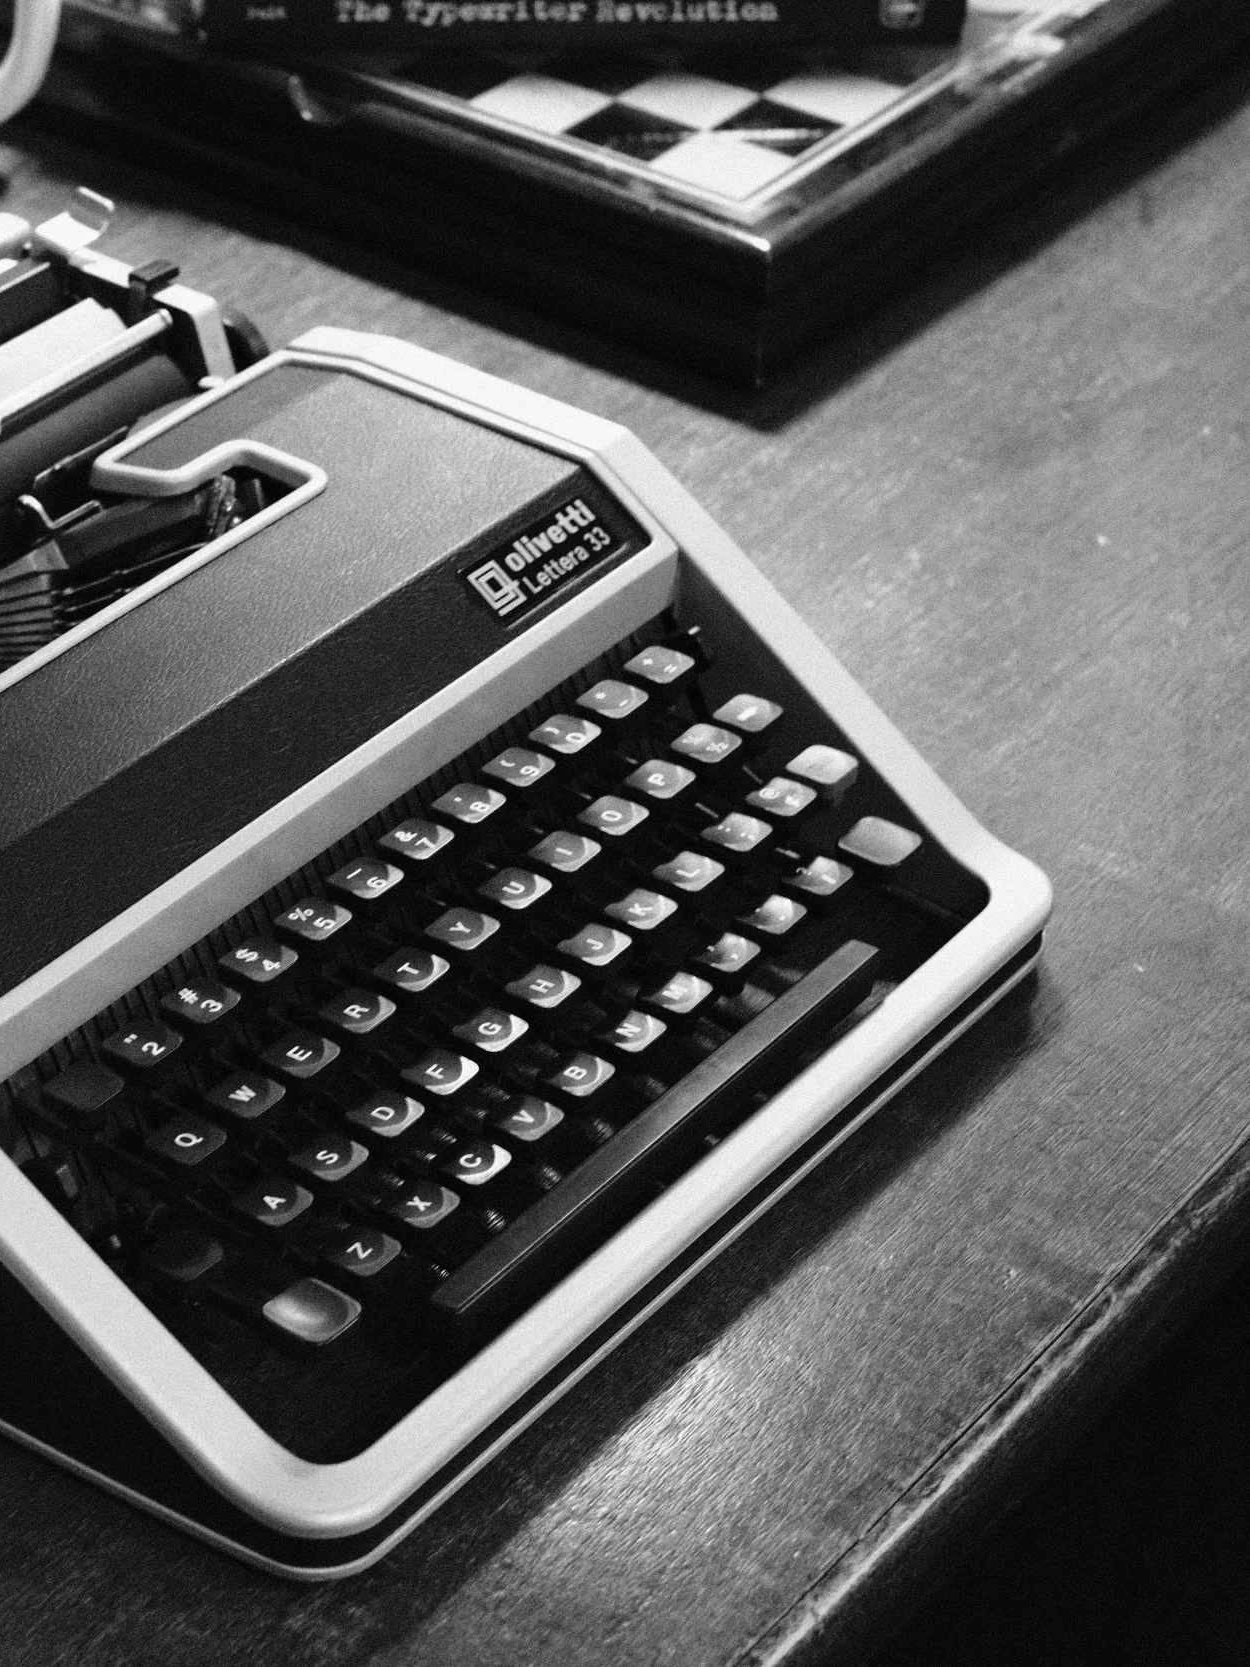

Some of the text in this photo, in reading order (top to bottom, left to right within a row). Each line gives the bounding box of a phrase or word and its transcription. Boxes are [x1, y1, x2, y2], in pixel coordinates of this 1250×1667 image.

[336, 0, 778, 27] The Typewriter Revolution
[504, 499, 596, 572] olivetti
[521, 526, 611, 595] Lettera 33
[142, 1041, 166, 1056] 2
[200, 998, 223, 1013] 3
[262, 959, 281, 972] 4
[313, 916, 336, 930] 5
[366, 876, 387, 889] 6
[414, 836, 437, 849] 7
[469, 801, 491, 813] 8
[520, 765, 541, 777] 9
[174, 1132, 204, 1148] Q
[228, 1085, 257, 1101] W
[286, 1045, 313, 1061] E
[343, 1004, 370, 1019] R
[396, 962, 419, 975] T
[449, 921, 471, 933] Y
[501, 880, 525, 895] U
[262, 1195, 286, 1210] A
[316, 1149, 339, 1165] S
[370, 1106, 395, 1121] D
[424, 1063, 445, 1080] F
[477, 1021, 502, 1036] G
[529, 978, 555, 994] H
[585, 938, 604, 950] J
[345, 1241, 374, 1259] Z
[405, 1195, 433, 1212] X
[459, 1153, 482, 1168] C
[511, 1109, 535, 1124] V
[563, 1066, 588, 1081] B
[615, 1022, 642, 1038] N
